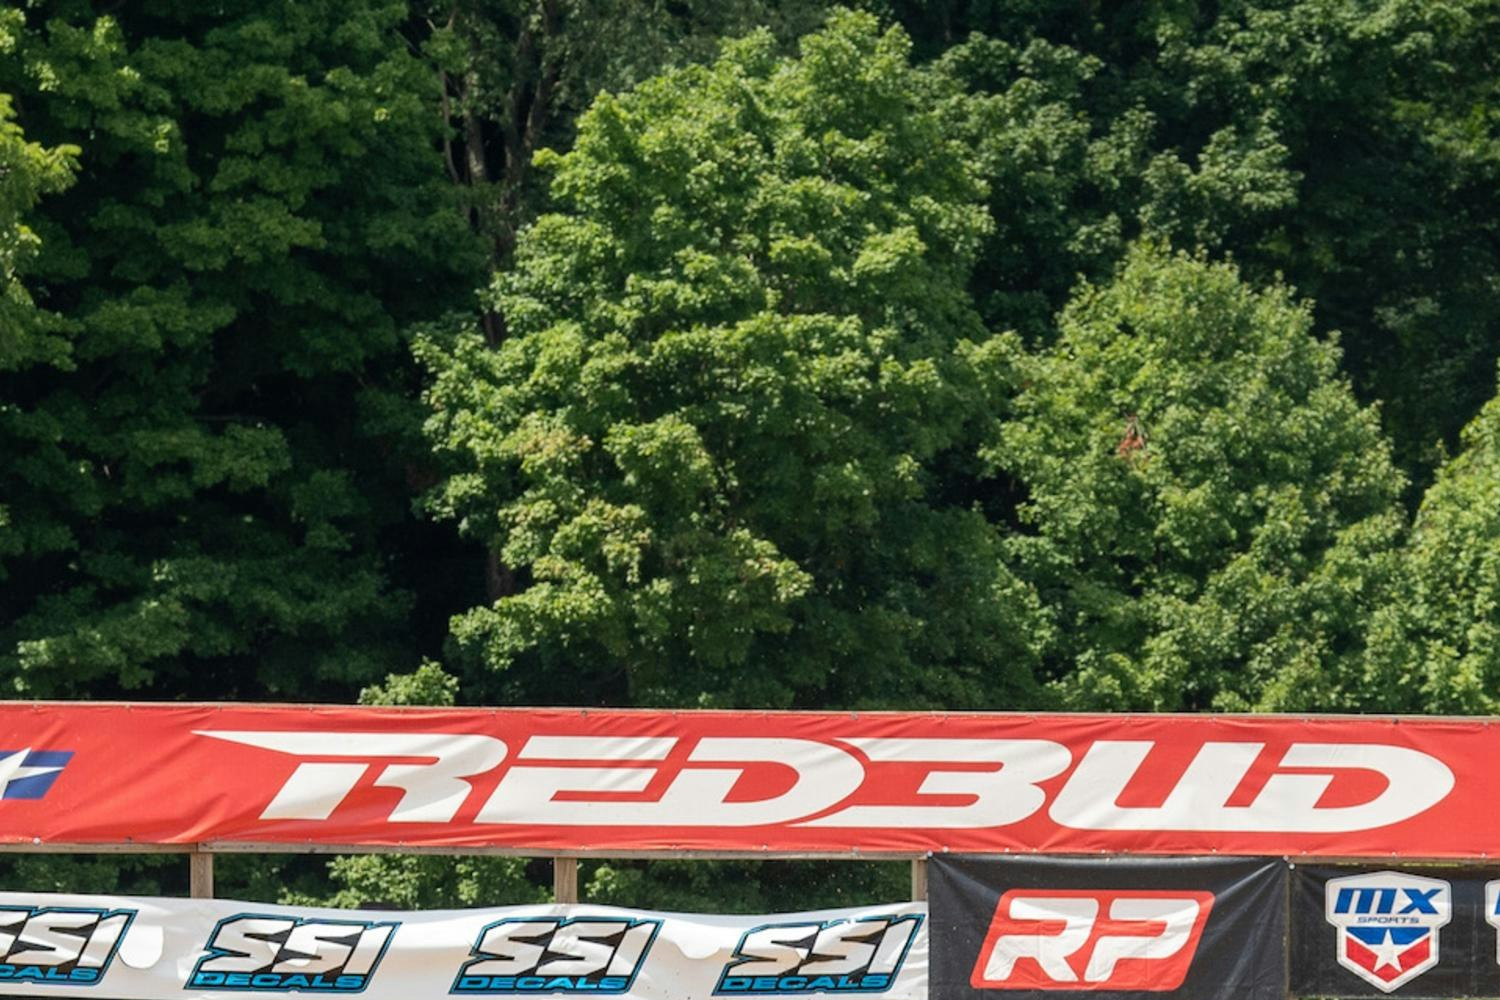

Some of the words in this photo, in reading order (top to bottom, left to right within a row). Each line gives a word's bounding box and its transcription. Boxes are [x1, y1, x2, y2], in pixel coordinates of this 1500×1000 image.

[191, 730, 1455, 833] REDBUD
[1334, 888, 1444, 914] MX
[1357, 916, 1420, 924] SPORTS
[196, 914, 400, 976] SSI
[462, 918, 658, 977] SSI
[724, 917, 922, 978] SSI
[983, 897, 1200, 982] RP
[196, 972, 365, 990] DECALS
[458, 975, 628, 991] DECALS
[722, 974, 889, 991] DECALS
